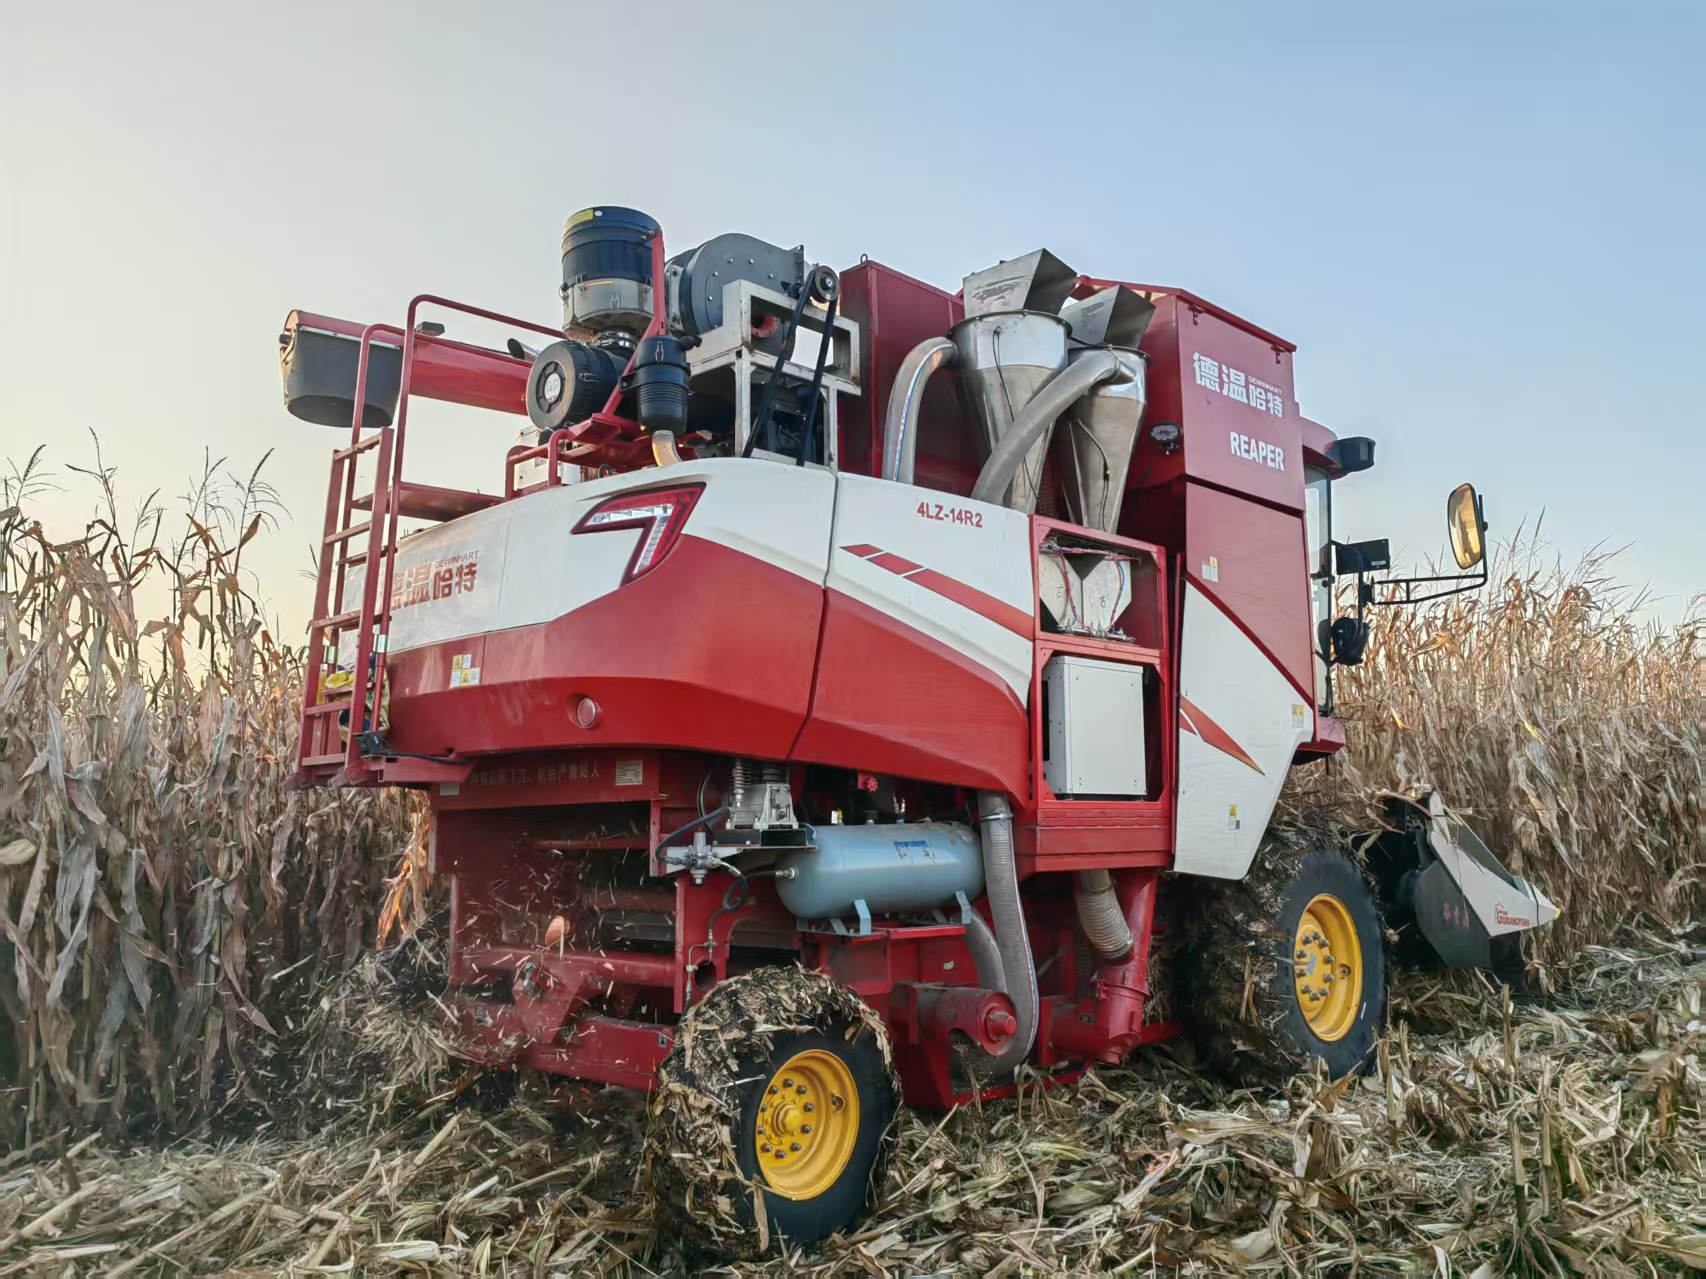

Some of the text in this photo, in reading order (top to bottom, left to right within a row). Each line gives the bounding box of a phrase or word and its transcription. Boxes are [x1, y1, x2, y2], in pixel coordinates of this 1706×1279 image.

[1193, 352, 1283, 419] 德温哈特
[1230, 431, 1285, 471] REAPER
[916, 501, 983, 528] 4LZ-14R2
[435, 550, 479, 569] DEWINHART
